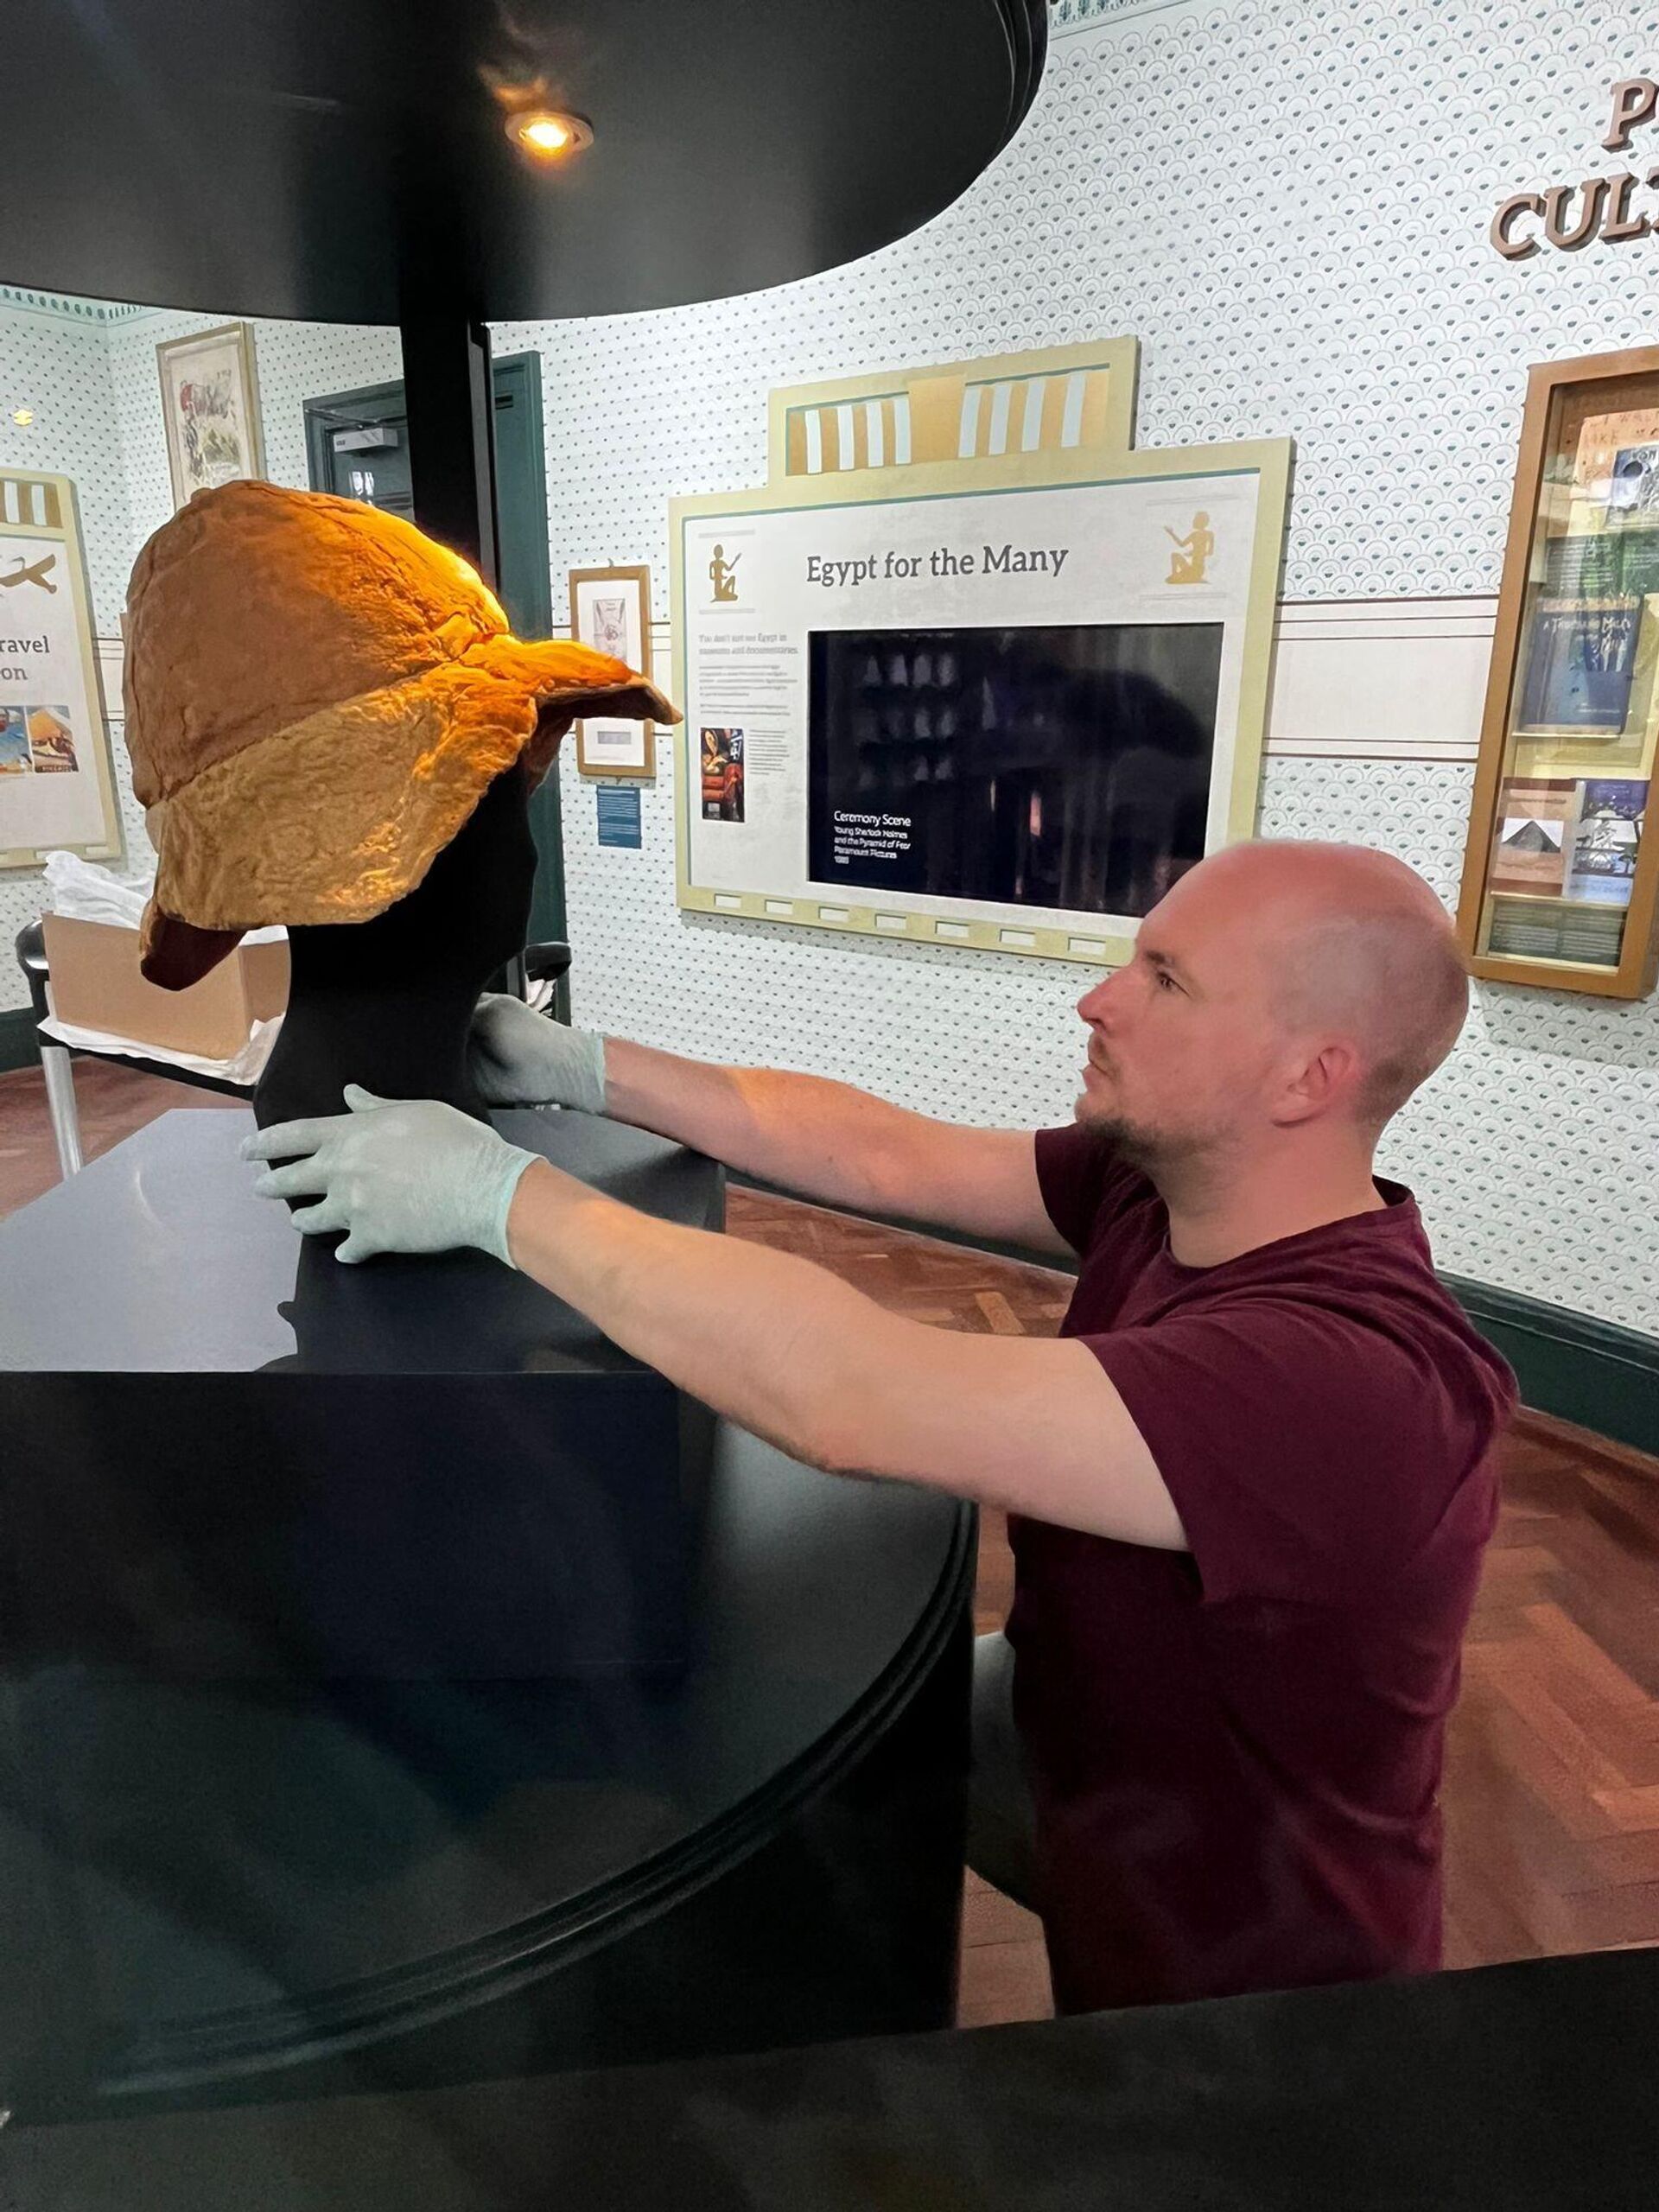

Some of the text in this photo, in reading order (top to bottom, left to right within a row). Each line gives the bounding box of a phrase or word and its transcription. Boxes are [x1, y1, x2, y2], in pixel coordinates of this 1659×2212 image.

[1490, 166, 1659, 260] CUL
[806, 544, 1069, 587] Egypt for the Many
[0, 667, 29, 680] on
[834, 810, 912, 827] Ceremony Scene
